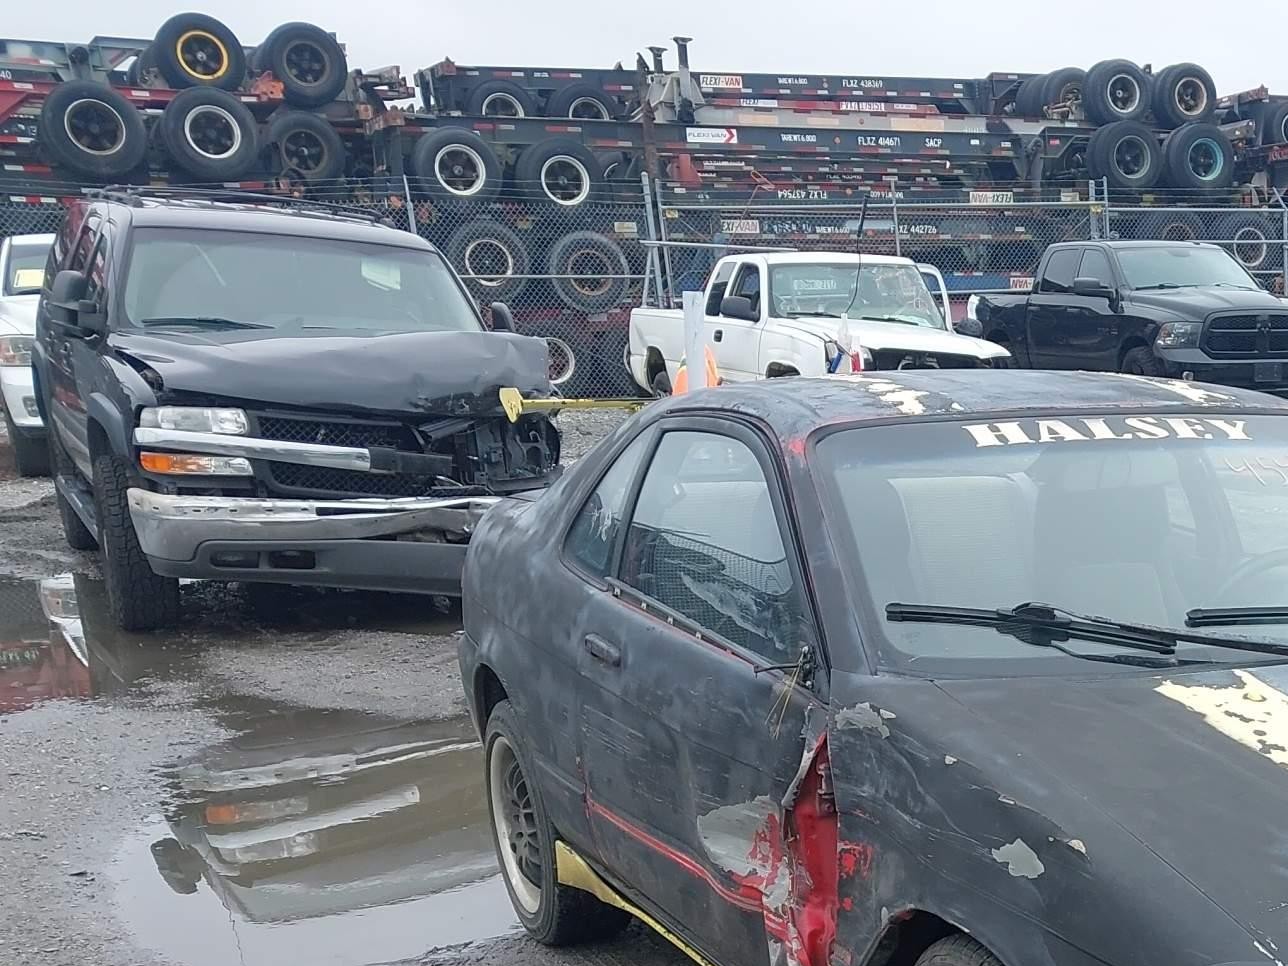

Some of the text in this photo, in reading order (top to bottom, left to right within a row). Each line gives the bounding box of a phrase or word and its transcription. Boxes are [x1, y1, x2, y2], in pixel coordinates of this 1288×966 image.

[701, 76, 742, 88] FLEXI-VAN
[858, 136, 876, 146] FLXZ
[809, 189, 828, 200] FLXZ
[910, 225, 937, 235] 442726
[961, 417, 1255, 449] HALSEY
